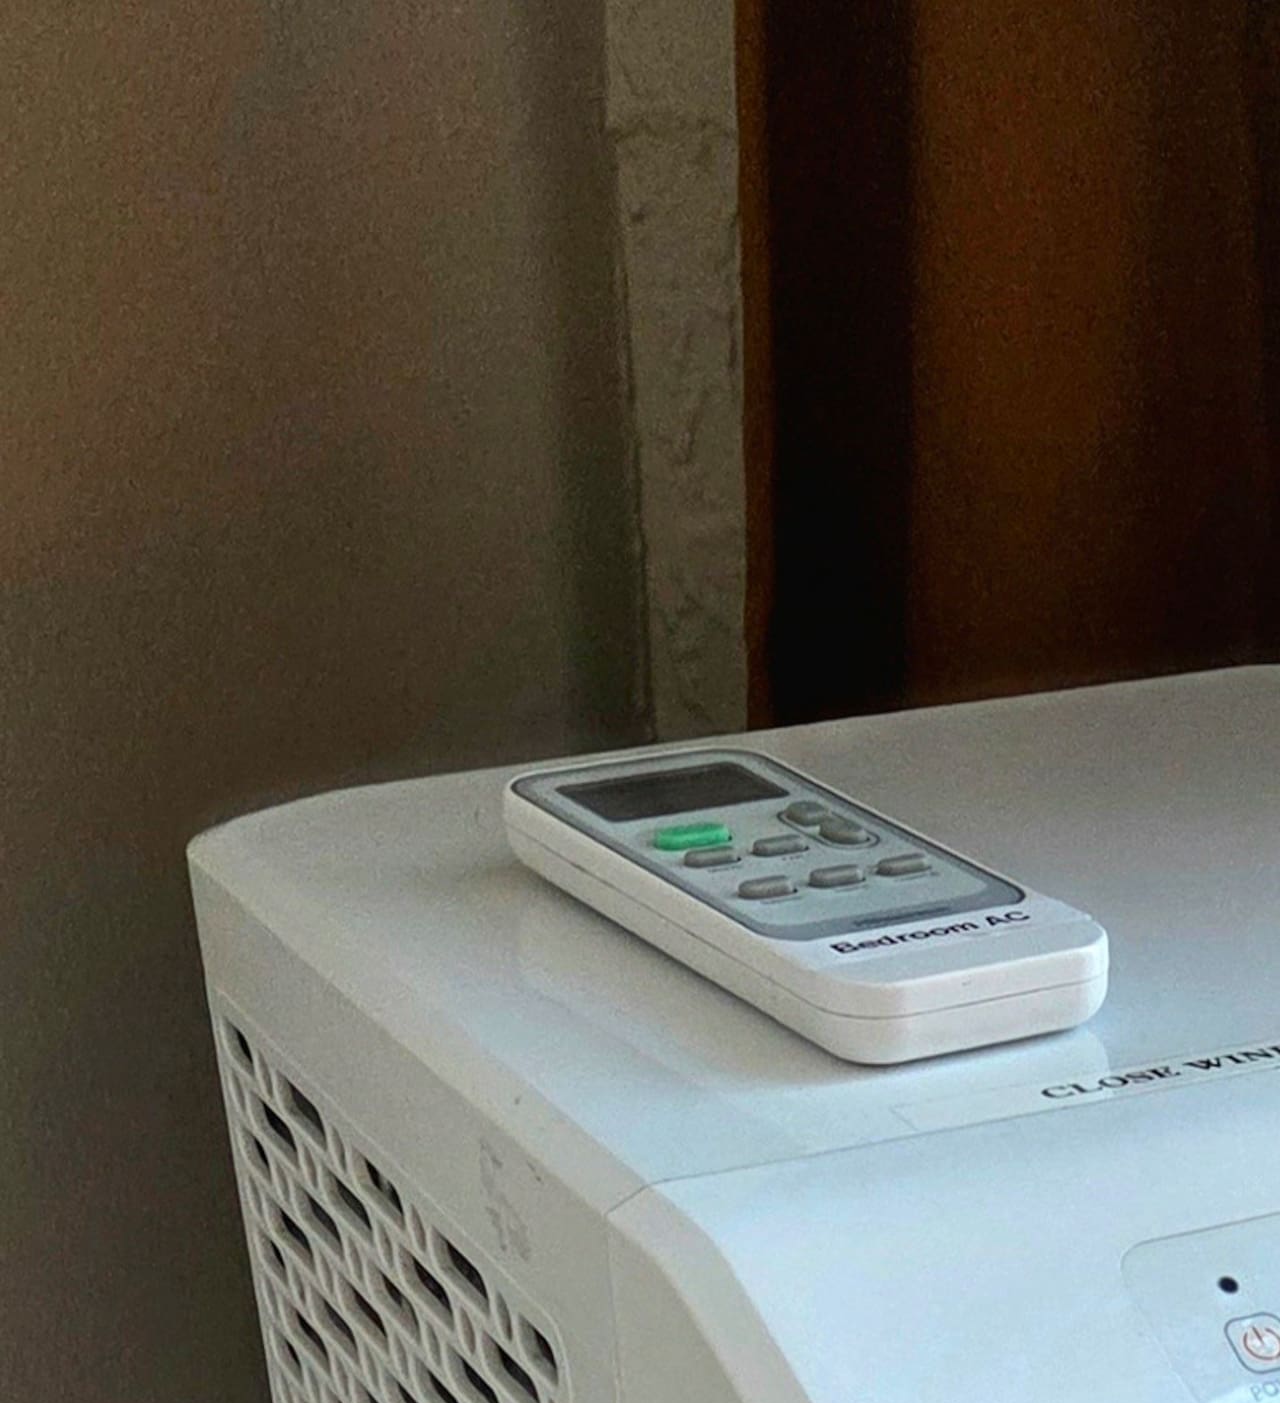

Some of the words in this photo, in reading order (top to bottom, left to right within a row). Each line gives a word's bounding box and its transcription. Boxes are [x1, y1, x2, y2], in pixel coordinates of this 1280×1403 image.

[830, 921, 980, 954] Bedroom
[985, 910, 1030, 928] AC
[1040, 1065, 1182, 1101] CLOSE
